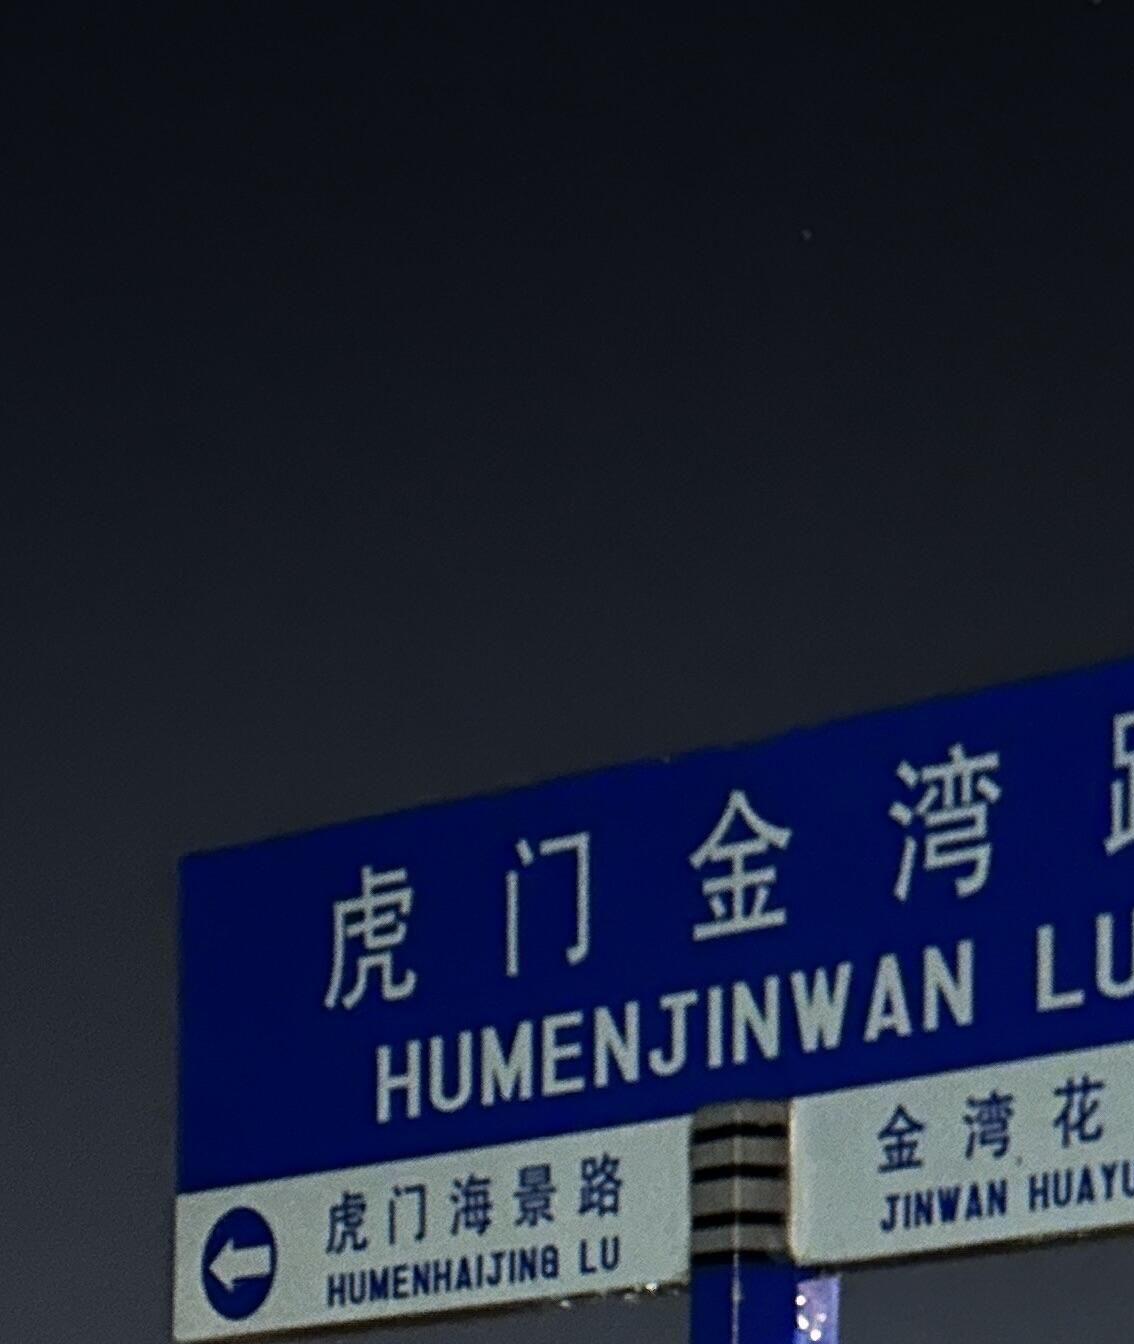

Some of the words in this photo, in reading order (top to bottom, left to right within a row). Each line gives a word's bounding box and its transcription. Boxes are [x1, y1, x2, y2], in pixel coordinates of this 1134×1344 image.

[375, 939, 974, 1124] HUMENJINWAN
[326, 1152, 622, 1254] 虎门海景路
[880, 1178, 1008, 1233] JINWAN
[327, 1244, 559, 1307] HUMENHAIJING
[578, 1235, 621, 1275] LU
